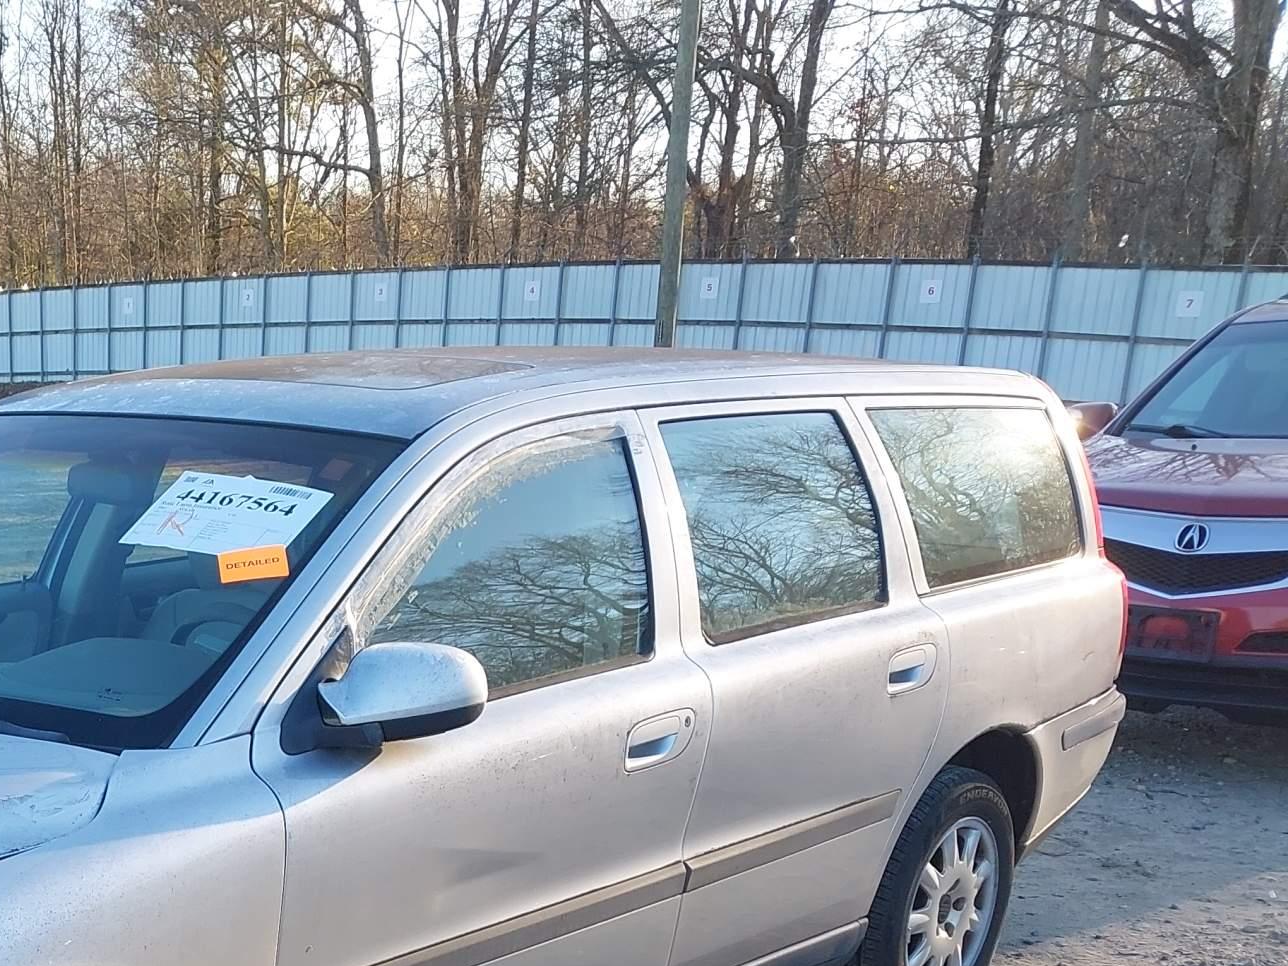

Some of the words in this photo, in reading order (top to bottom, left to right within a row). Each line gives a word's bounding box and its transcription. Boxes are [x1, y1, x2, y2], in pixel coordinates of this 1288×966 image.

[706, 283, 713, 292] 5
[928, 286, 935, 295] 6
[1186, 299, 1194, 308] 7
[176, 489, 298, 516] 44167564
[225, 557, 280, 570] DETAILED
